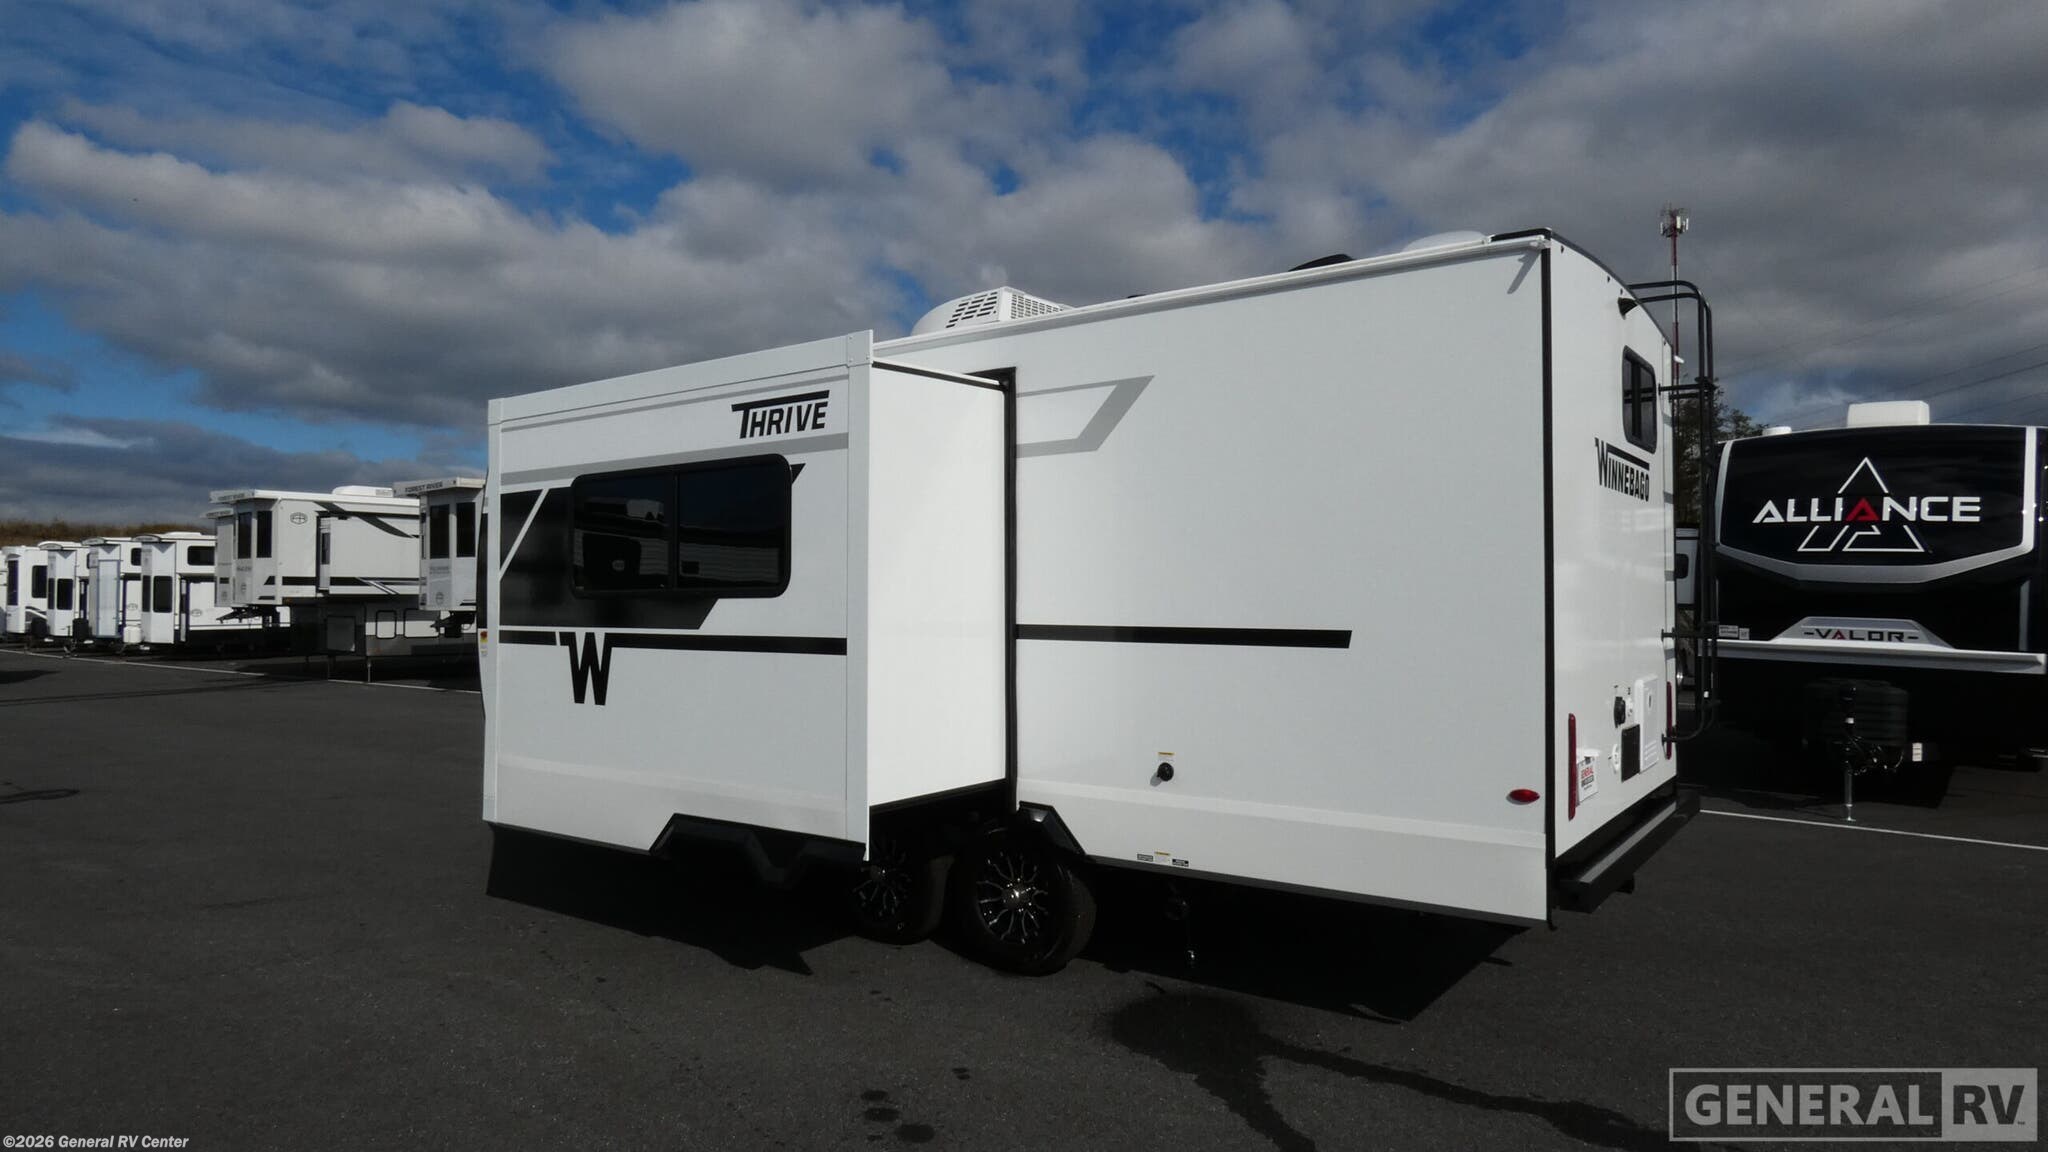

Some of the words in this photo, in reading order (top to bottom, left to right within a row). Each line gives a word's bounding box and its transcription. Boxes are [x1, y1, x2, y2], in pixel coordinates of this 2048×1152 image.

[731, 390, 830, 439] THRIVE
[1594, 436, 1650, 502] WINNEBAGO
[1752, 496, 1981, 524] ALLIANCE
